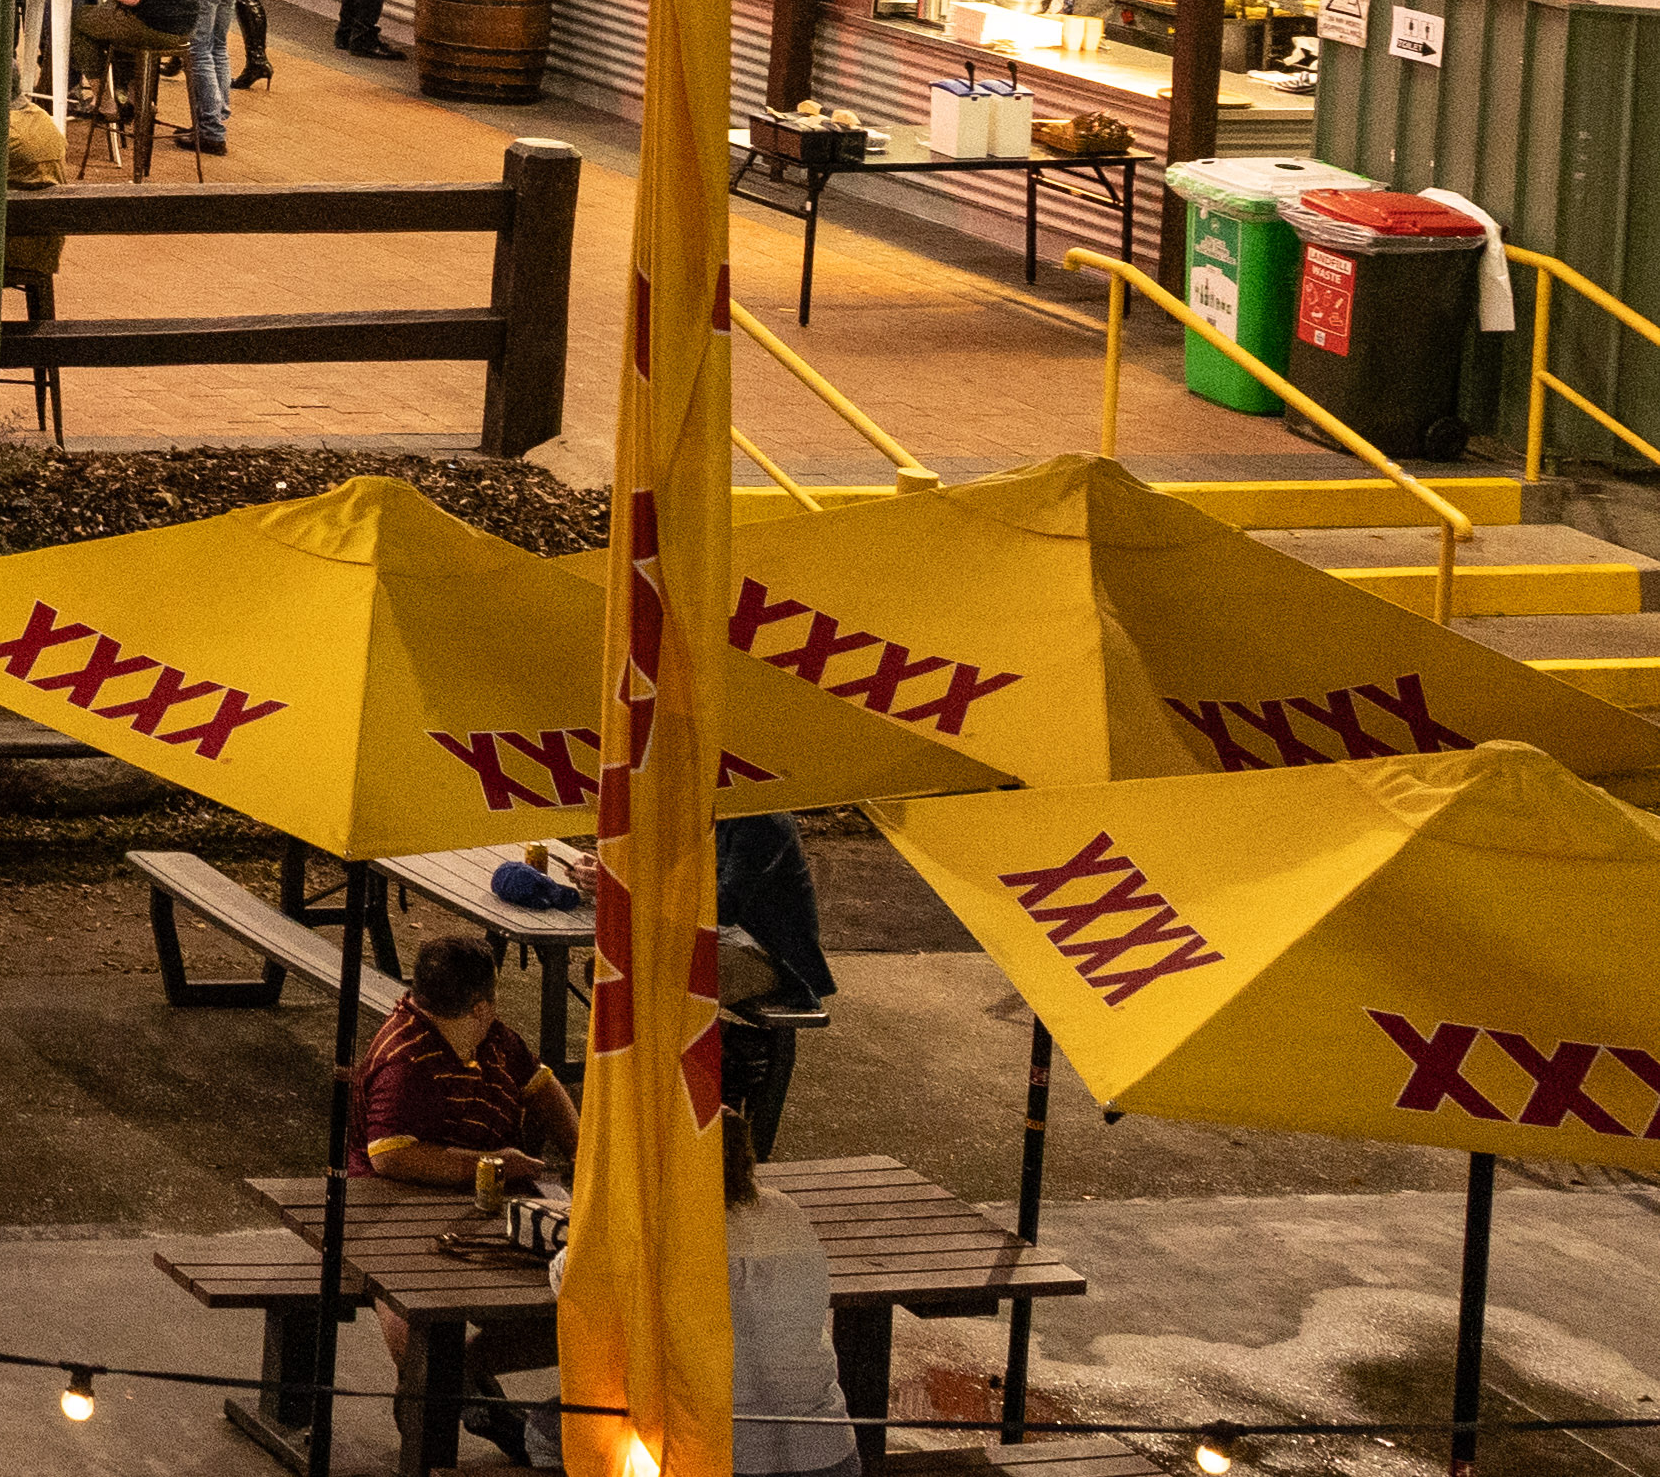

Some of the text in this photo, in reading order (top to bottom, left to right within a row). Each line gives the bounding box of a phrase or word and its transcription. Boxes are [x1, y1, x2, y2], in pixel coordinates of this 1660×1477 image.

[1308, 249, 1352, 274] LANDFILL
[1312, 266, 1343, 285] WASTE
[1163, 672, 1477, 774] XXXX
[426, 726, 780, 812] XX
[997, 829, 1226, 1010] XXXX
